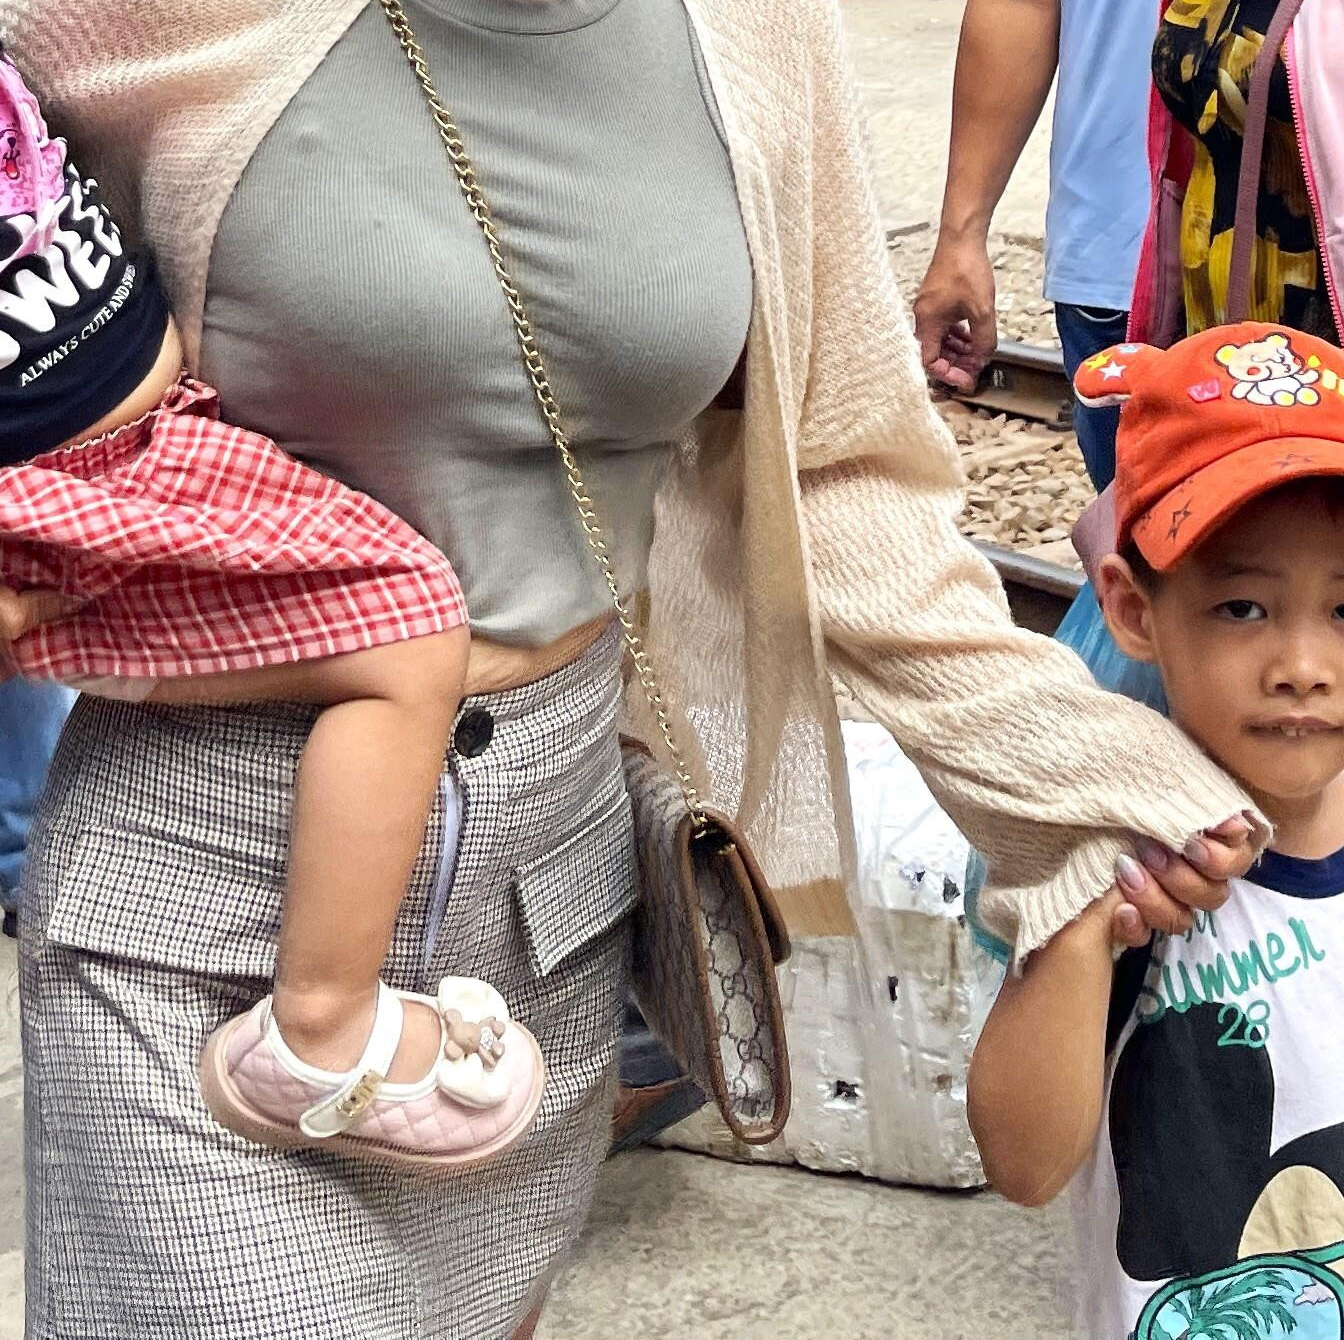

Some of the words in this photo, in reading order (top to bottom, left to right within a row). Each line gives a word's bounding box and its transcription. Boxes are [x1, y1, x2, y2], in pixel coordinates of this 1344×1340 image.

[19, 335, 80, 388] ALWAYS
[80, 305, 114, 341] CUTE
[109, 284, 131, 313] AND
[1216, 998, 1271, 1048] 28
